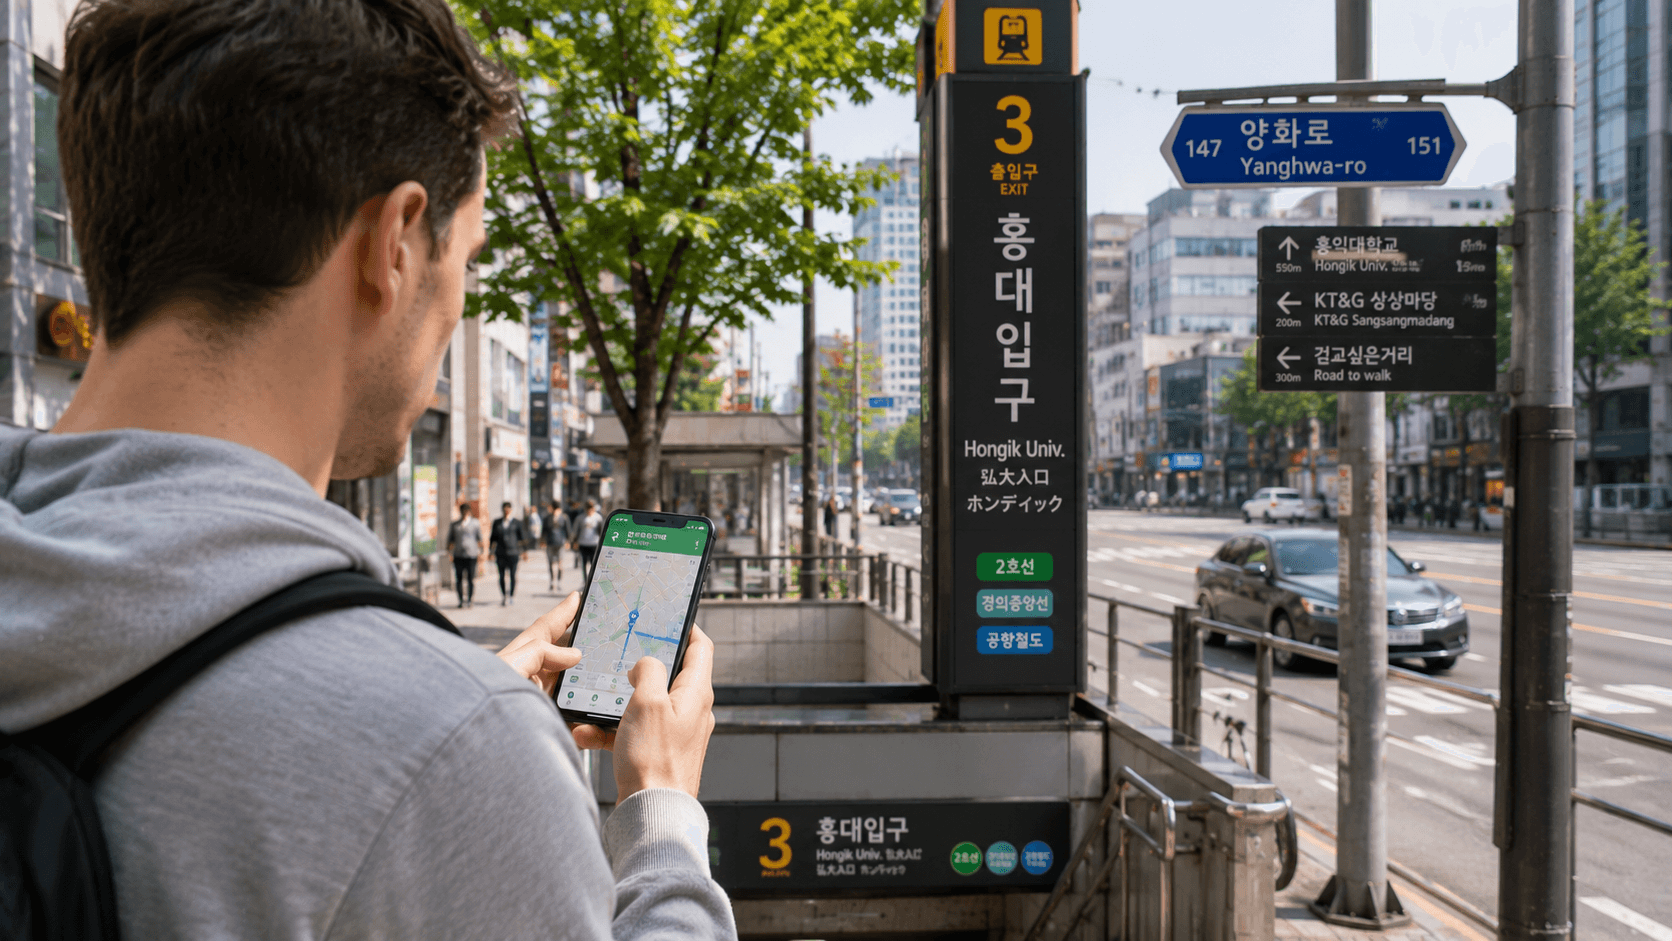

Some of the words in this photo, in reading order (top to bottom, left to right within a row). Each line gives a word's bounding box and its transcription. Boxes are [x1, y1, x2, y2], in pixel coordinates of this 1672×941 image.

[994, 94, 1034, 155] 3
[1240, 118, 1333, 151] 양화로
[1185, 139, 1222, 158] 147
[1407, 136, 1441, 155] 151
[1240, 156, 1367, 180] Yanghwa-ro
[1000, 183, 1028, 195] EXIT
[1315, 235, 1399, 255] 홍익대학교
[1315, 259, 1356, 274] Hongik
[1360, 259, 1388, 272] Univ.
[1314, 292, 1365, 308] KT&G
[1370, 291, 1438, 311] 상상마당
[993, 212, 1035, 423] 홍대입구
[1275, 318, 1302, 327] 200m
[1314, 314, 1348, 326] KT&G
[1352, 314, 1454, 329] Sangsangmadang
[1275, 373, 1302, 382] 300m
[1314, 369, 1344, 381] Road
[1348, 371, 1361, 381] to
[1364, 369, 1392, 381] walk
[964, 439, 1022, 462] Hongik
[1026, 439, 1066, 458] Univ.
[995, 558, 1035, 576] 2호선
[986, 632, 1044, 650] 공항철도
[816, 816, 909, 844] 홍대입구
[759, 817, 792, 869] 3
